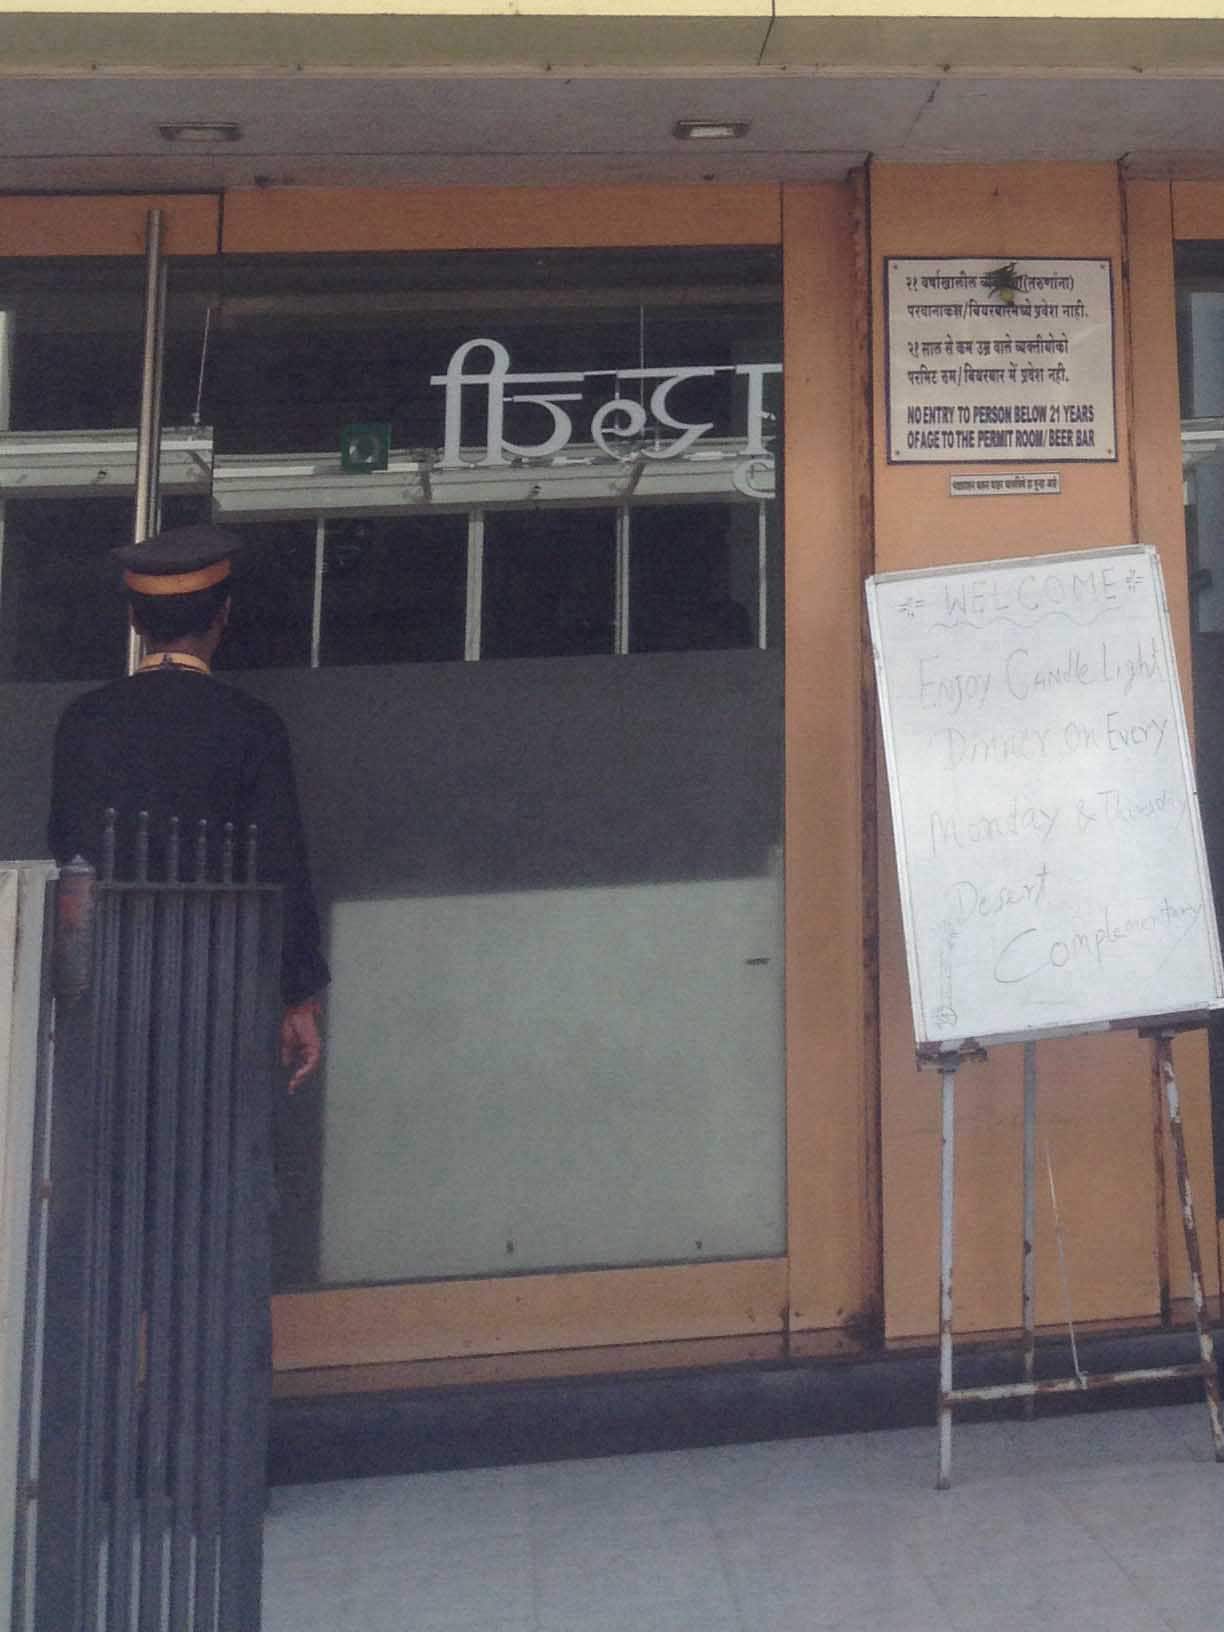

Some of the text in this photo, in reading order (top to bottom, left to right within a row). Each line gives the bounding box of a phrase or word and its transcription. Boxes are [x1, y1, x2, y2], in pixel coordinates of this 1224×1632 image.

[907, 341, 919, 358] २१
[921, 342, 942, 357] साल
[944, 334, 954, 355] से
[993, 333, 1012, 355] वाले
[907, 364, 937, 385] परमिट
[1021, 361, 1044, 384] प्रवेश
[907, 405, 1095, 424] NO ENTRY TO PERSON BELOW 21 YEARS
[907, 431, 920, 448] OF
[920, 431, 940, 448] AGE
[942, 431, 954, 448] TO
[955, 430, 975, 448] THE
[978, 430, 1013, 447] PERMIT
[1049, 429, 1074, 446] BEER
[1075, 429, 1095, 446] BAR
[944, 568, 1117, 617] WELCOME
[928, 796, 1061, 857] Monday
